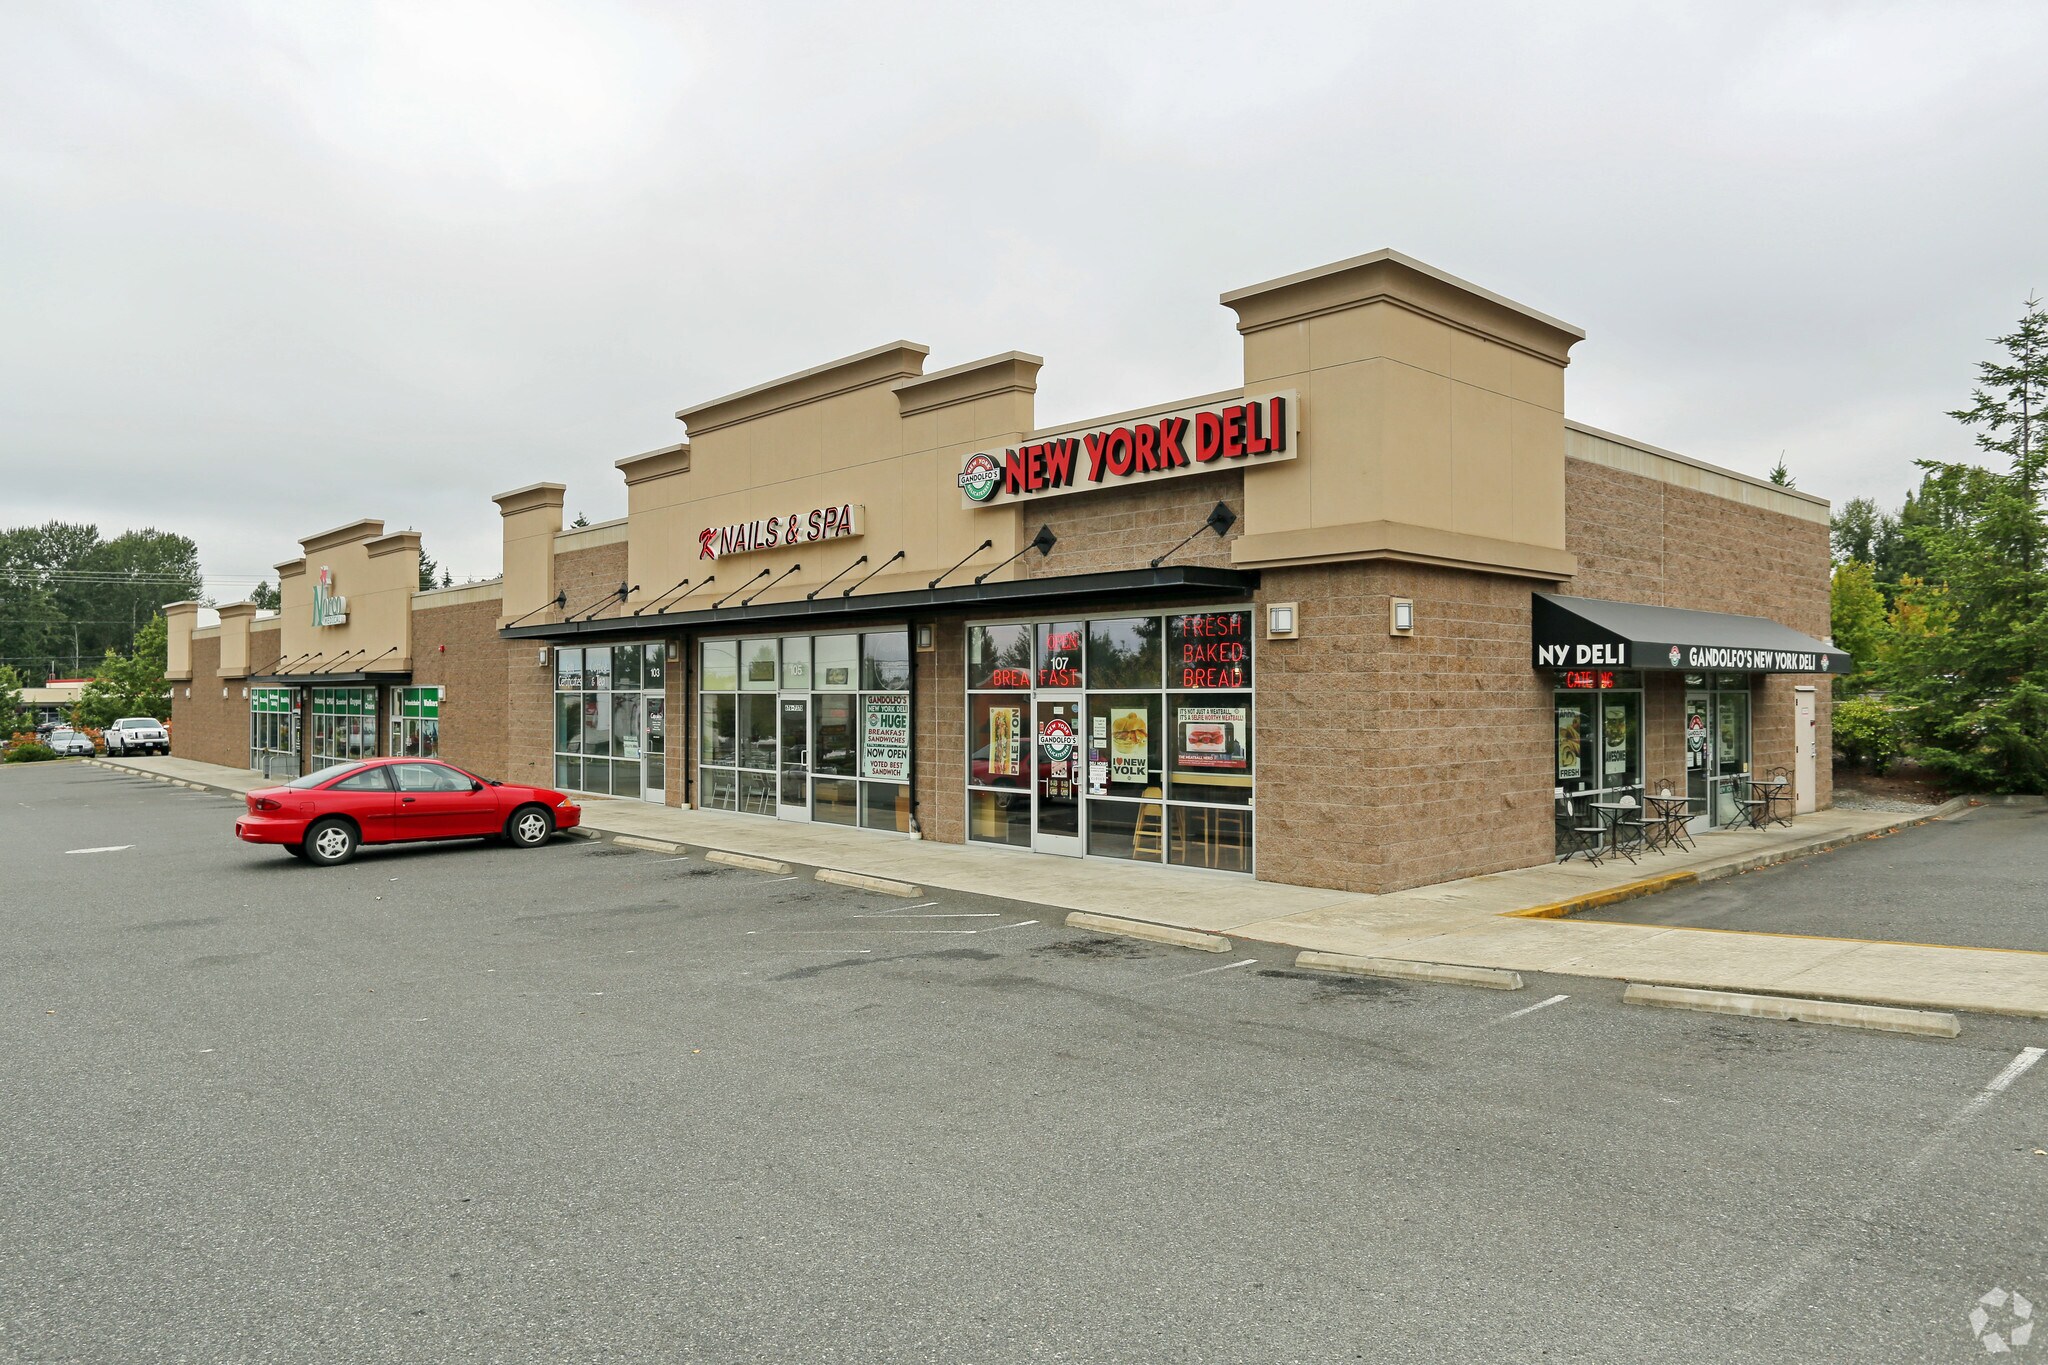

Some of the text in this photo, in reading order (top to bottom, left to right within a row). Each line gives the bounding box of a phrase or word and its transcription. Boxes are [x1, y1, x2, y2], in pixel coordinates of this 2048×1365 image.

[1005, 396, 1286, 495] NEW YORK DELI
[967, 458, 992, 474] NEW YORK
[961, 471, 998, 484] GANDOLFO'S
[720, 517, 779, 555] NAILS
[785, 514, 799, 545] &
[807, 504, 852, 542] SPA
[1183, 615, 1241, 638] FRESH
[1047, 633, 1079, 651] OPEN
[1183, 642, 1243, 663] BAKED
[1538, 643, 1625, 666] NY DELI
[1689, 646, 1753, 668] GANDOLFO'S
[1754, 650, 1774, 669] NEW
[1775, 651, 1798, 670] YORK
[1799, 653, 1816, 671] DELI
[1050, 657, 1069, 670] 107
[650, 668, 661, 678] 103
[1183, 667, 1243, 688] BREAD
[868, 696, 906, 704] GANDOLFO'S
[880, 714, 906, 728] HUGE
[1046, 723, 1070, 735] NEW YORK
[1011, 709, 1020, 775] PILE IT ON
[1040, 736, 1077, 744] GANDOLFO'S
[867, 748, 907, 759] NOW OPEN
[1123, 758, 1146, 767] NEW
[872, 768, 900, 776] SANDWICH
[1113, 766, 1146, 776] YOLK
[1560, 769, 1580, 778] FRESH
